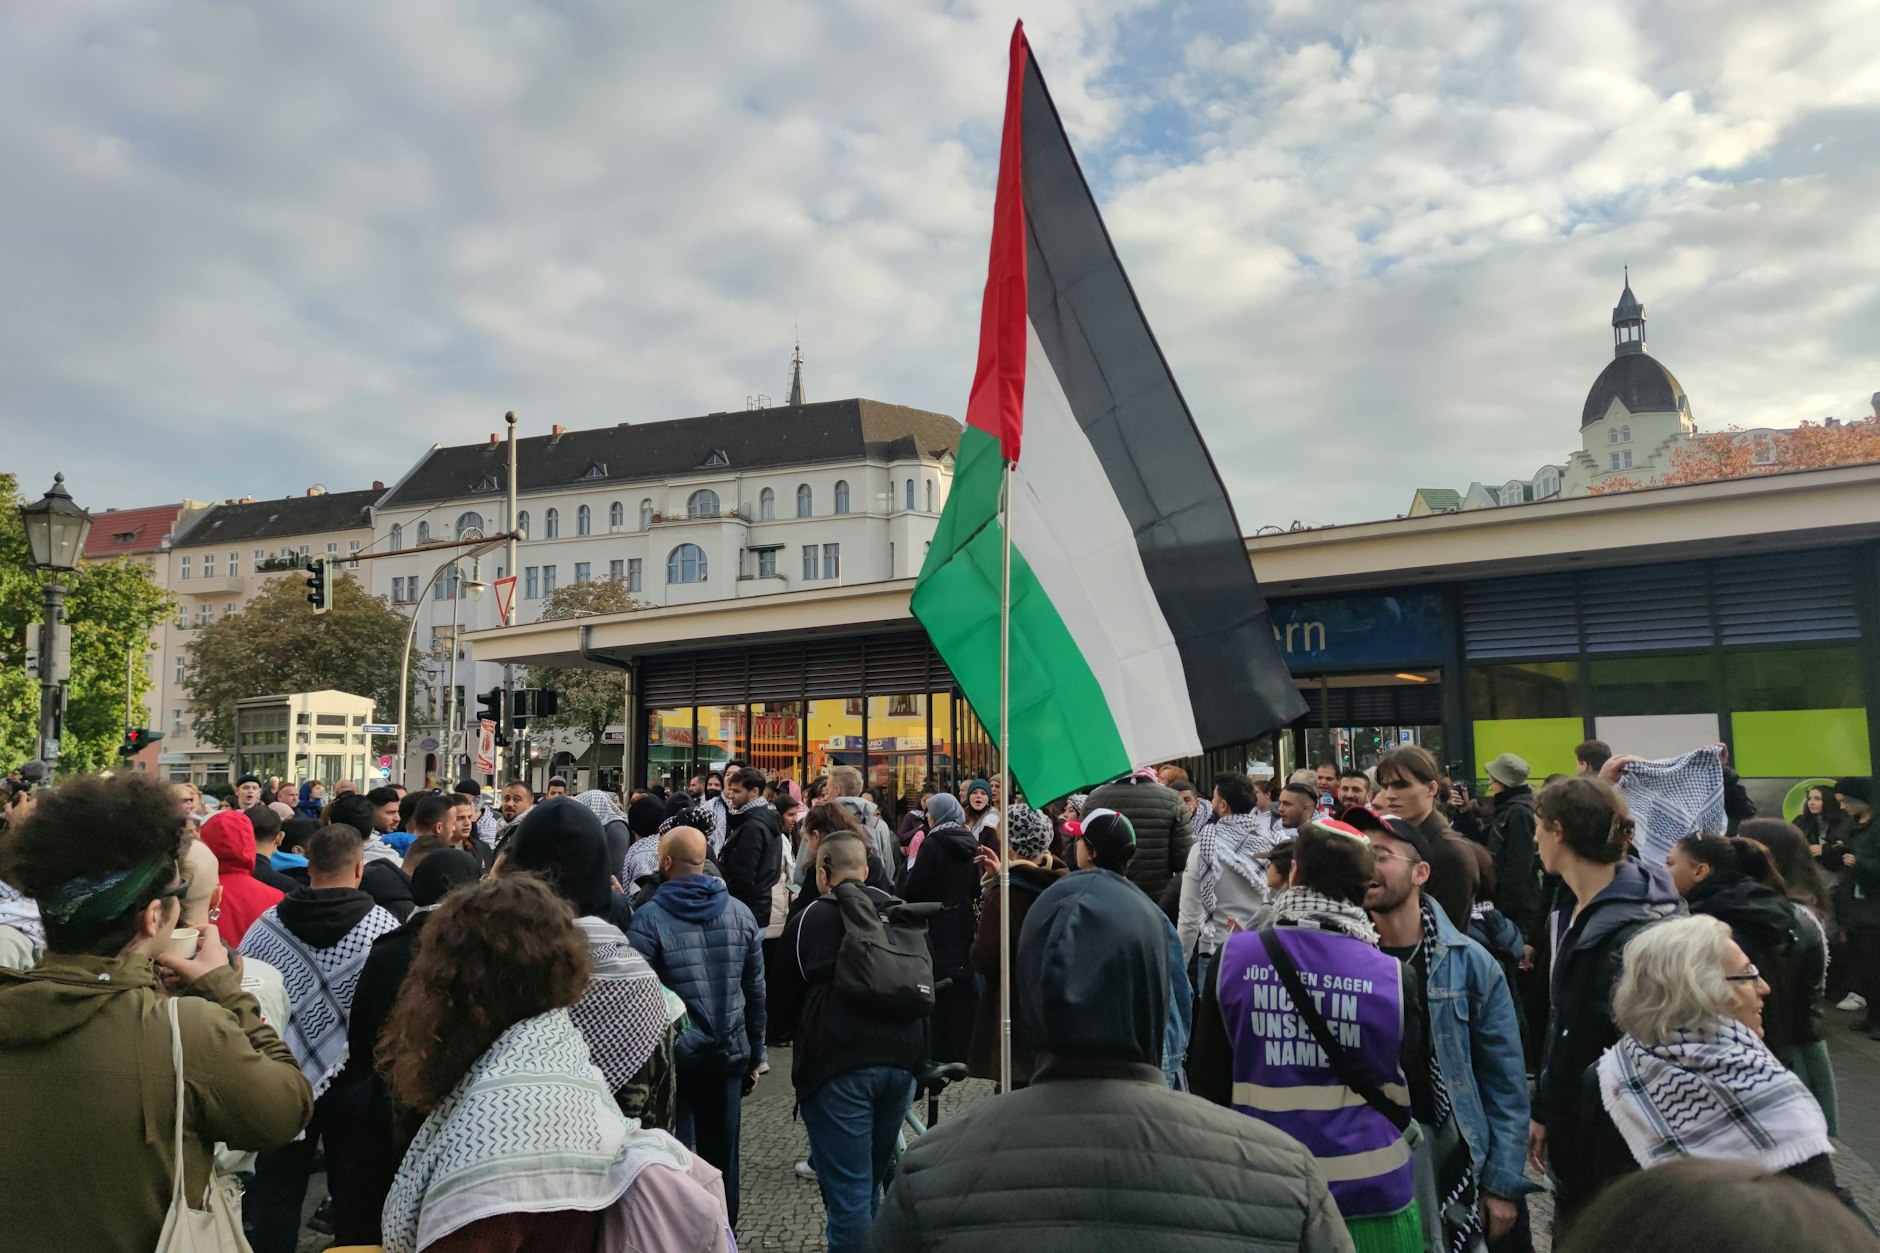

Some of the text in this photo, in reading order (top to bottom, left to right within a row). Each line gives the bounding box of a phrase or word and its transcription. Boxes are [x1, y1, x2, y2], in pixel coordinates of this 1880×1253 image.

[1242, 964, 1373, 994] JÜDIEN SAGEN
[1253, 984, 1358, 1021] NICT IN
[1251, 1011, 1361, 1048] UNSEEM
